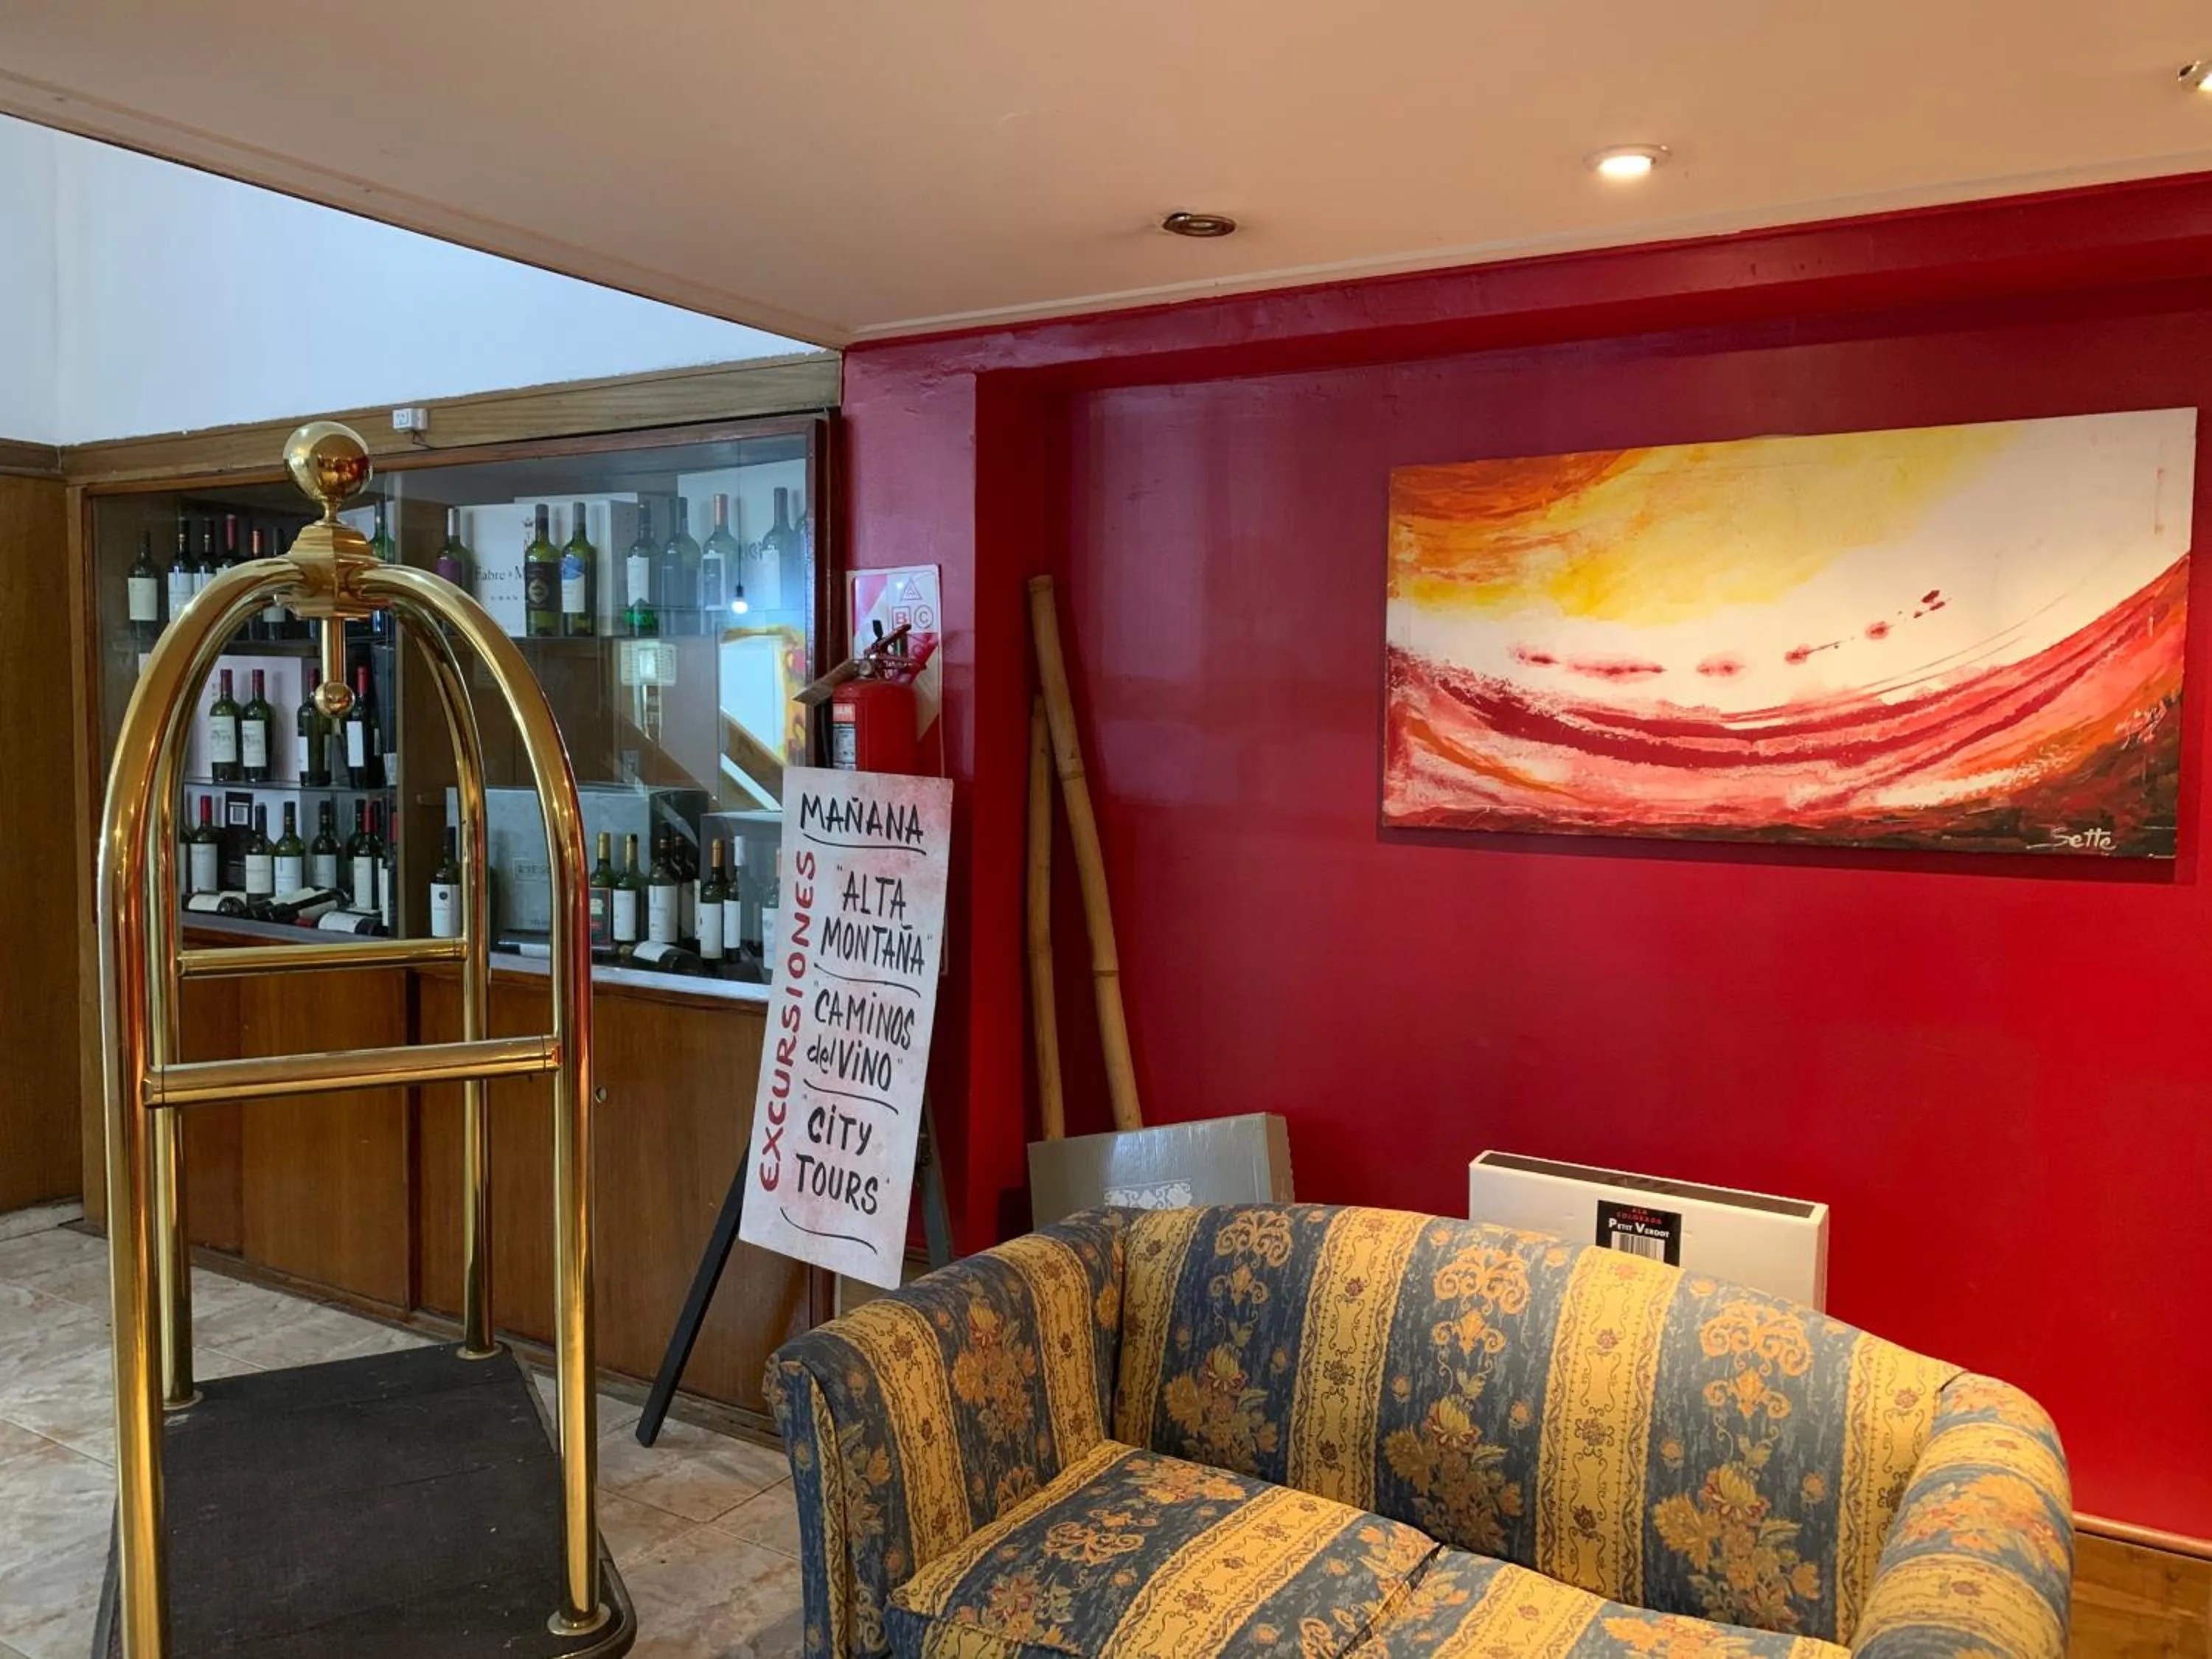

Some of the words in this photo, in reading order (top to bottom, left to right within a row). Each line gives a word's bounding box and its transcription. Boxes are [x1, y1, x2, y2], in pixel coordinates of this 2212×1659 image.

[896, 611, 907, 625] B
[919, 611, 928, 623] C
[801, 793, 923, 844] MAÑANA
[2027, 827, 2117, 850] Sette
[760, 850, 817, 1192] EXCURSIONES
